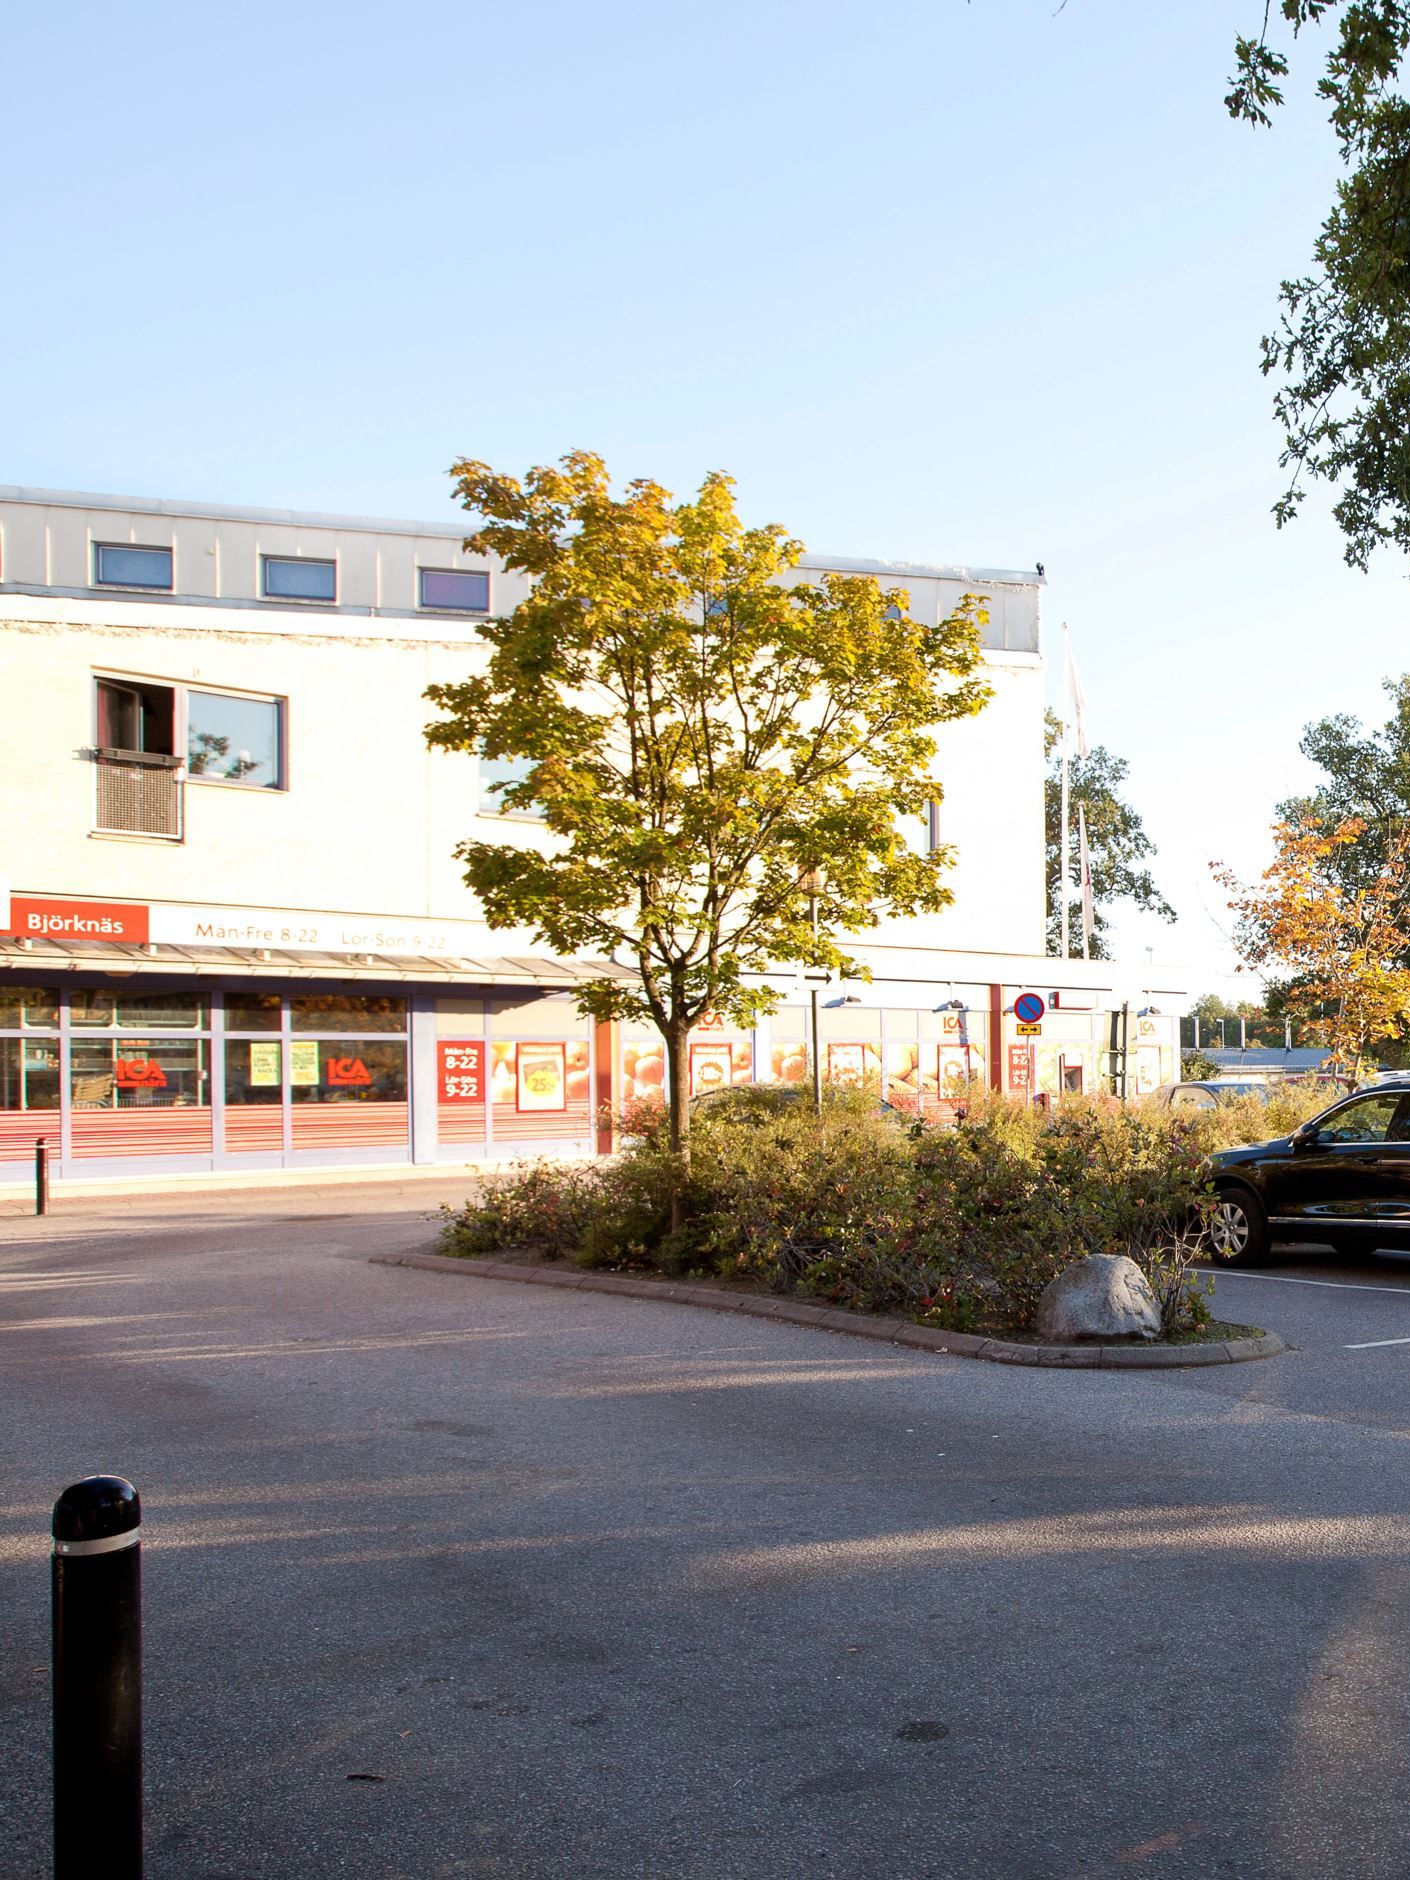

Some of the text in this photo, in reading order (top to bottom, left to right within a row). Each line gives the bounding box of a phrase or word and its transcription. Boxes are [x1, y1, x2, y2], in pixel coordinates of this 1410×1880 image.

[27, 913, 125, 935] Björknäs
[280, 928, 319, 944] 8-22
[943, 1016, 963, 1029] ICA
[1139, 1020, 1155, 1032] ICA
[445, 1055, 478, 1069] 8-22
[1012, 1054, 1028, 1065] 8-2
[115, 1057, 167, 1081] ICA
[327, 1056, 371, 1078] ICA
[1012, 1075, 1028, 1086] 9-2
[445, 1083, 478, 1097] 9-22
